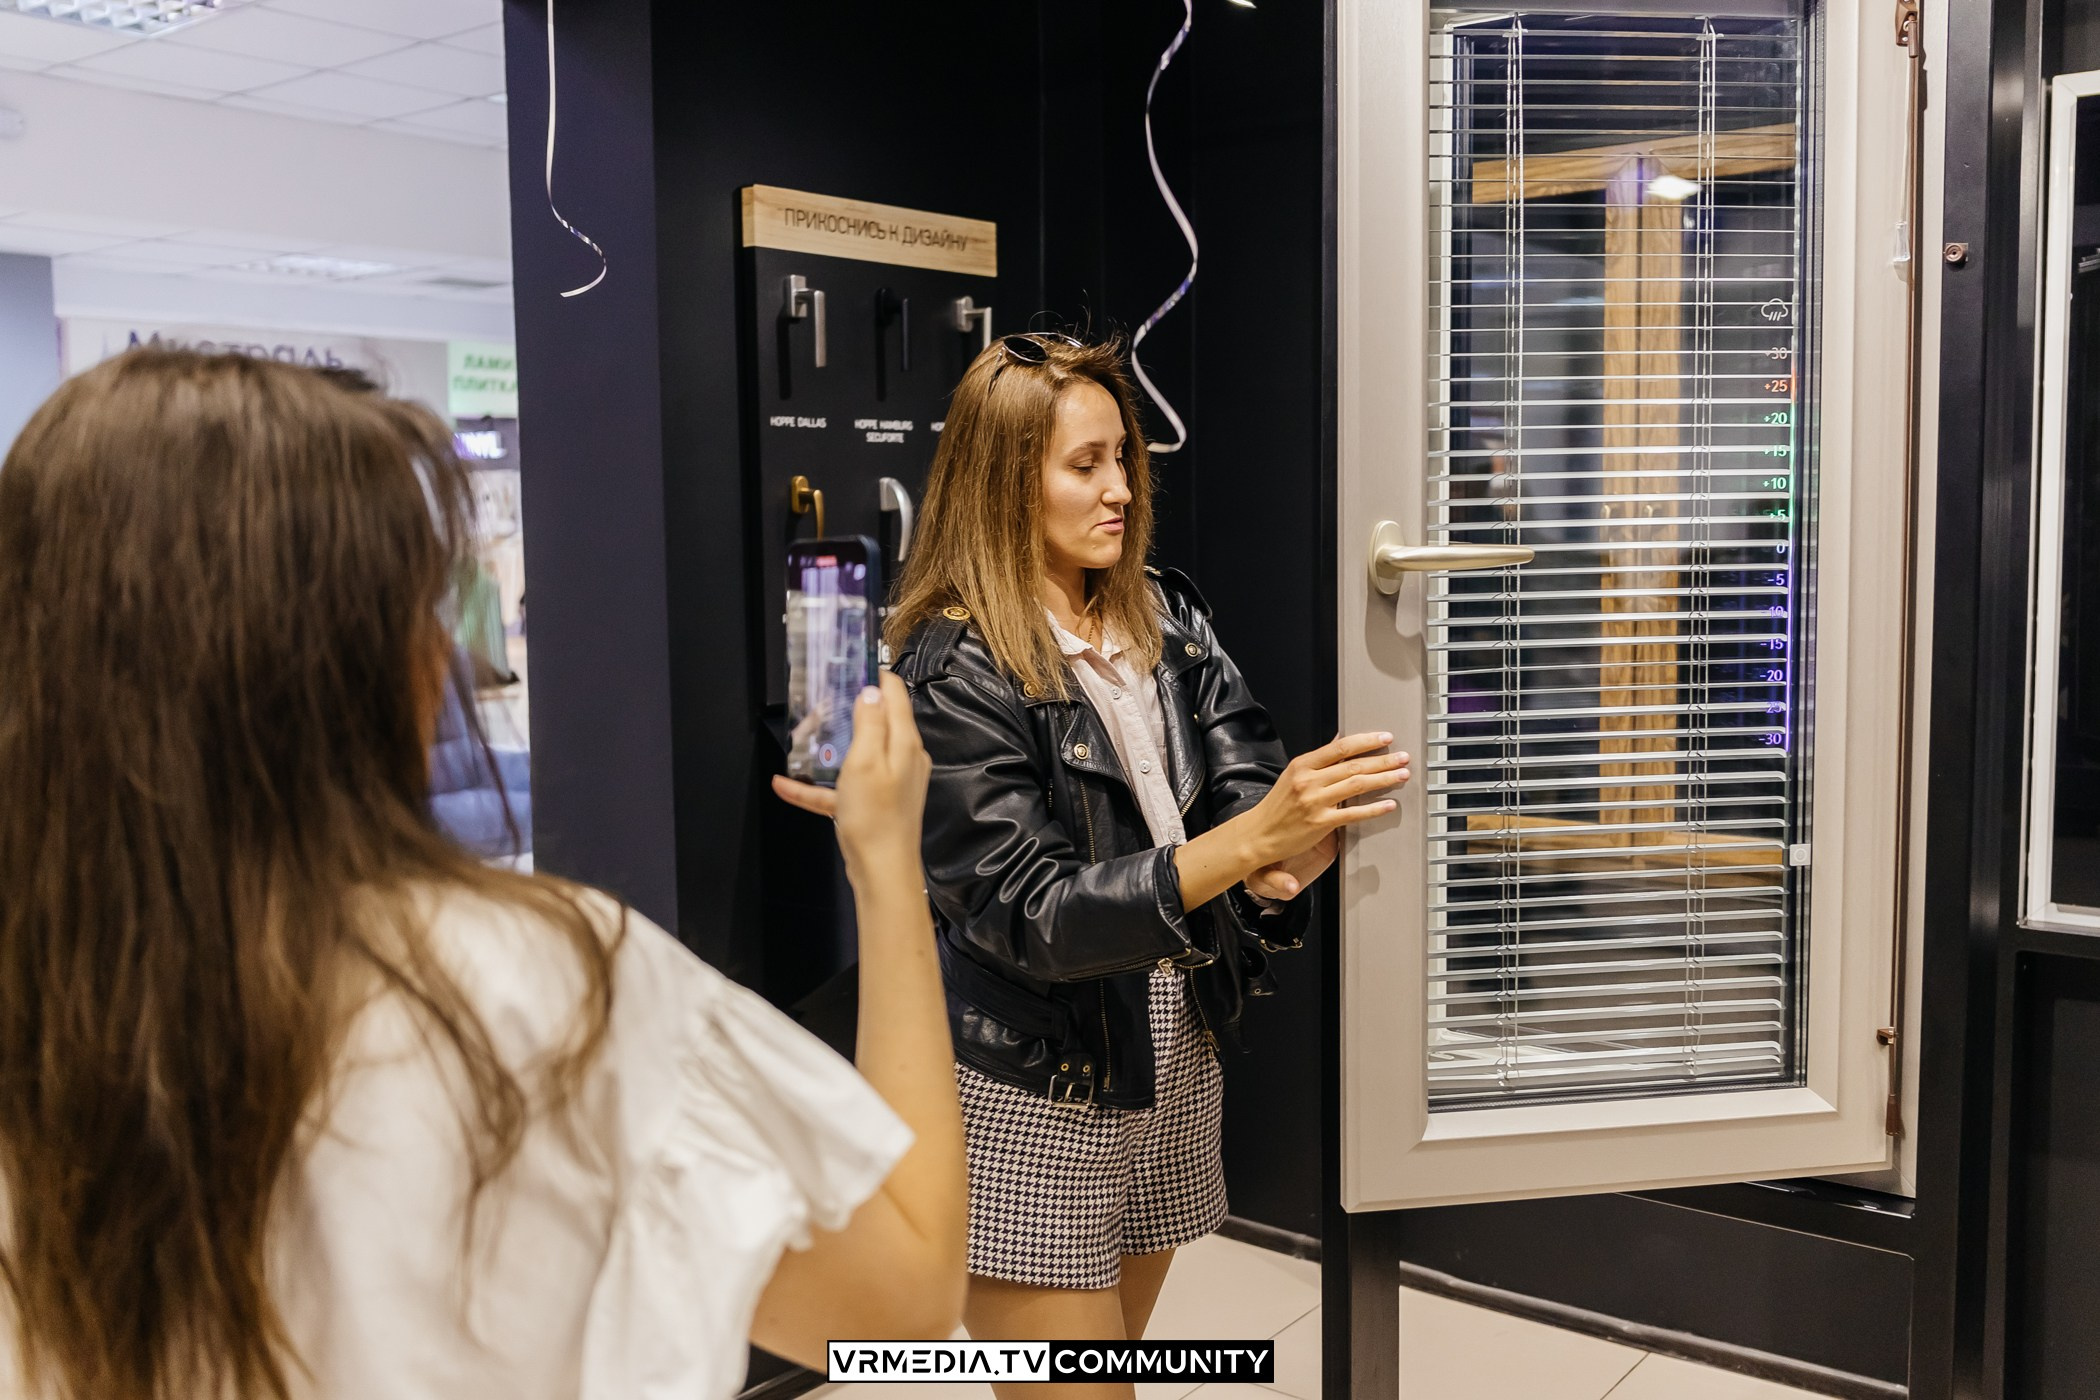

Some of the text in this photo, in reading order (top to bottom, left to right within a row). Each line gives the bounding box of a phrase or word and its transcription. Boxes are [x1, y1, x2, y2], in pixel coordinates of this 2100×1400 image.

[784, 207, 887, 241] ПРИКОСНИСЬ
[902, 225, 968, 252] ДИЗАЙНУ
[1764, 379, 1788, 393] +25
[1763, 412, 1788, 425] +20
[1763, 477, 1787, 490] +10
[1769, 509, 1786, 521] +5
[1767, 574, 1785, 586] -5
[1760, 638, 1784, 650] -15
[1760, 669, 1783, 681] -20
[1759, 733, 1782, 745] -30
